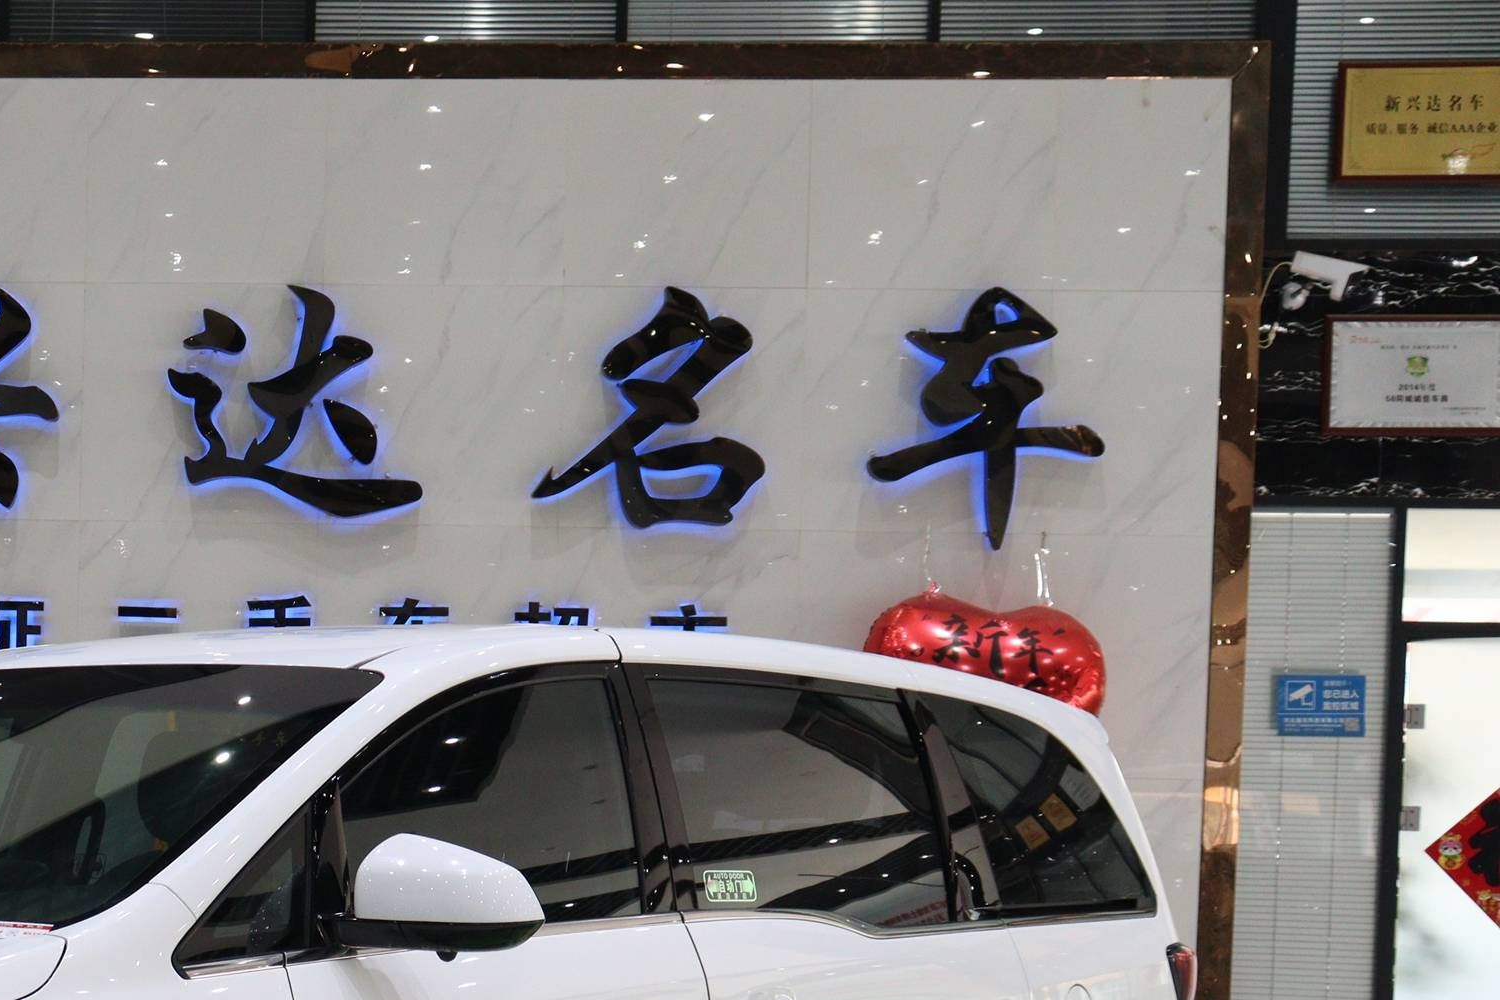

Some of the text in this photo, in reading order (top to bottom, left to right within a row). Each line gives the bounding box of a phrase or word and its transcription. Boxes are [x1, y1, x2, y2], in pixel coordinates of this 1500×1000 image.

[1385, 94, 1484, 112] 新兴达名车
[932, 614, 1052, 678] 新年
